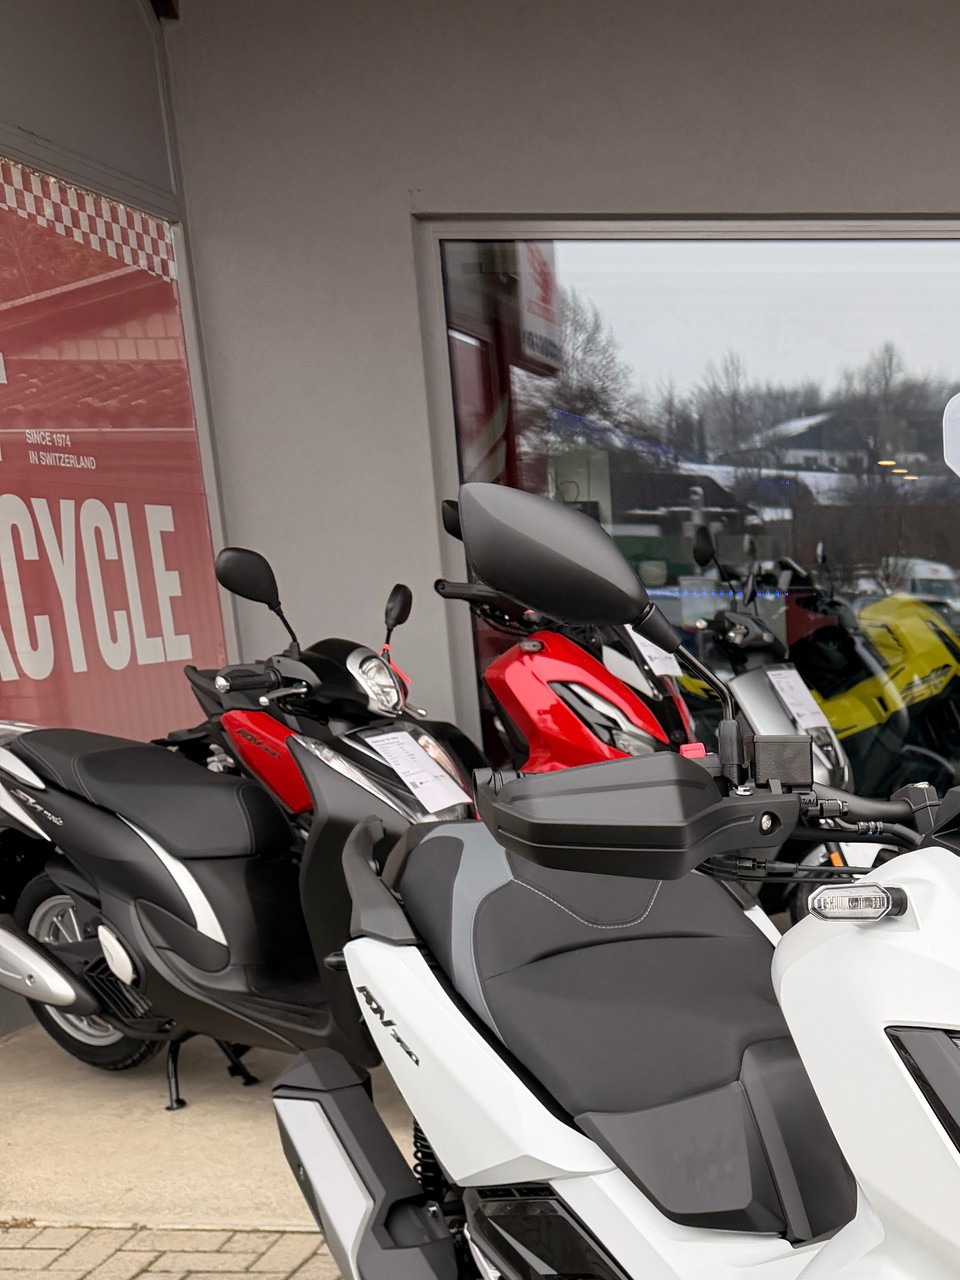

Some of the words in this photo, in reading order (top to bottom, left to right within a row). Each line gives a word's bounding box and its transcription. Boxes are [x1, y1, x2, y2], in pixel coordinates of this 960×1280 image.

[25, 429, 52, 446] SINCE
[53, 433, 71, 447] 1974
[28, 450, 39, 464] IN
[39, 451, 96, 469] SWITZERLAND
